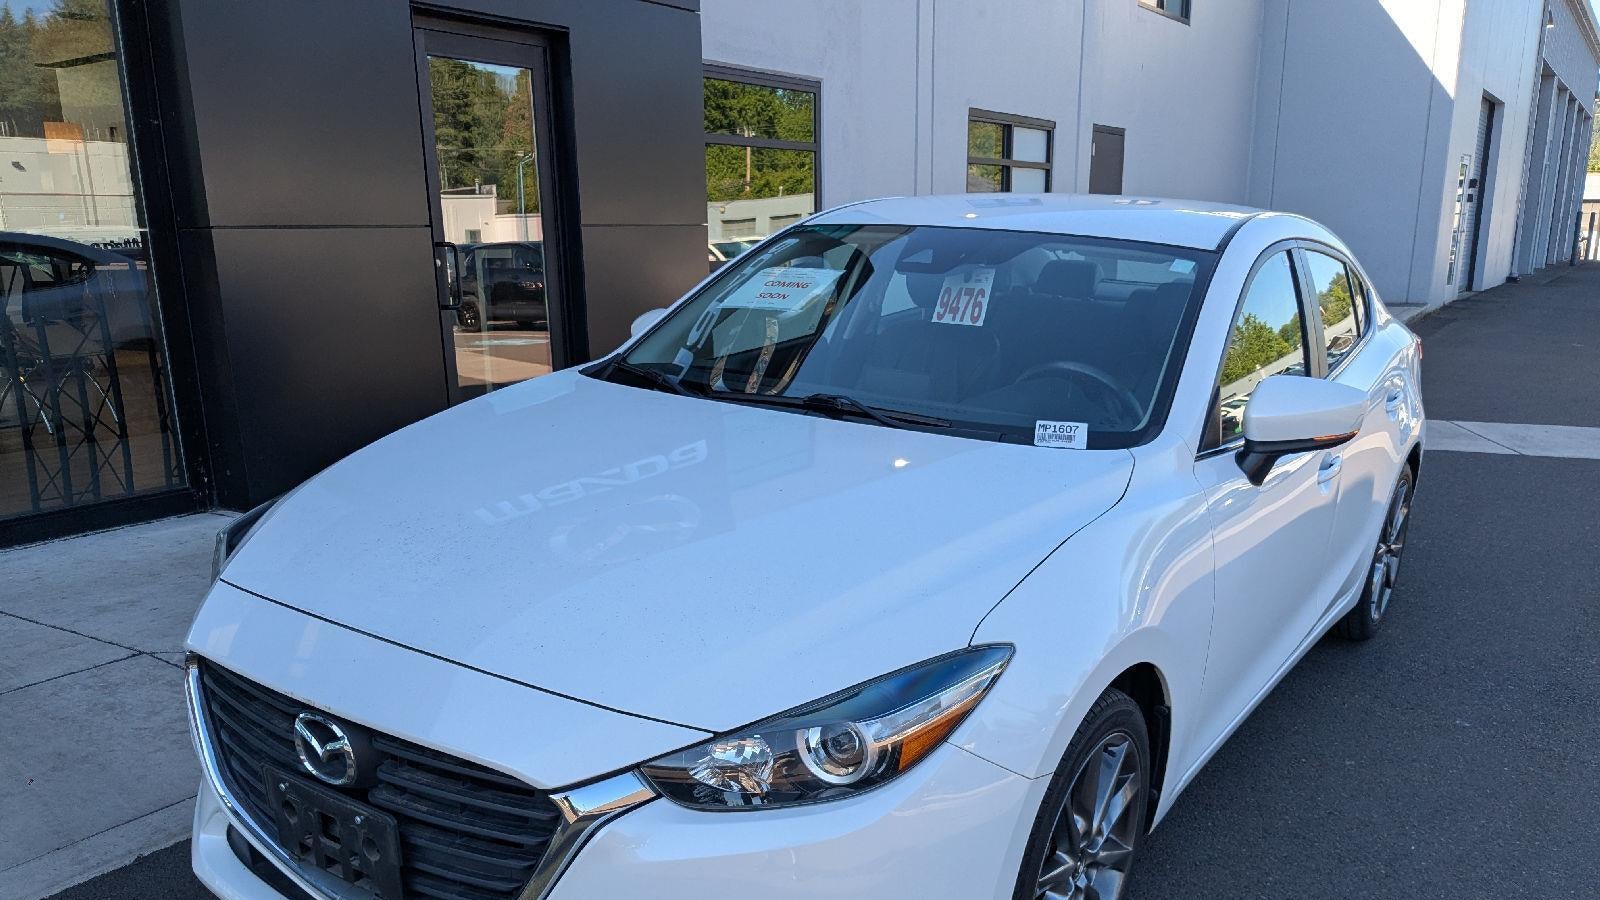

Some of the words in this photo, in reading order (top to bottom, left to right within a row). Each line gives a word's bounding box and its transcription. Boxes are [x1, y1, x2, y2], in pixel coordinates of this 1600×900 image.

[763, 280, 812, 289] COMING
[755, 292, 790, 300] SOON
[936, 287, 985, 324] 9476
[1037, 424, 1080, 434] MP1607
